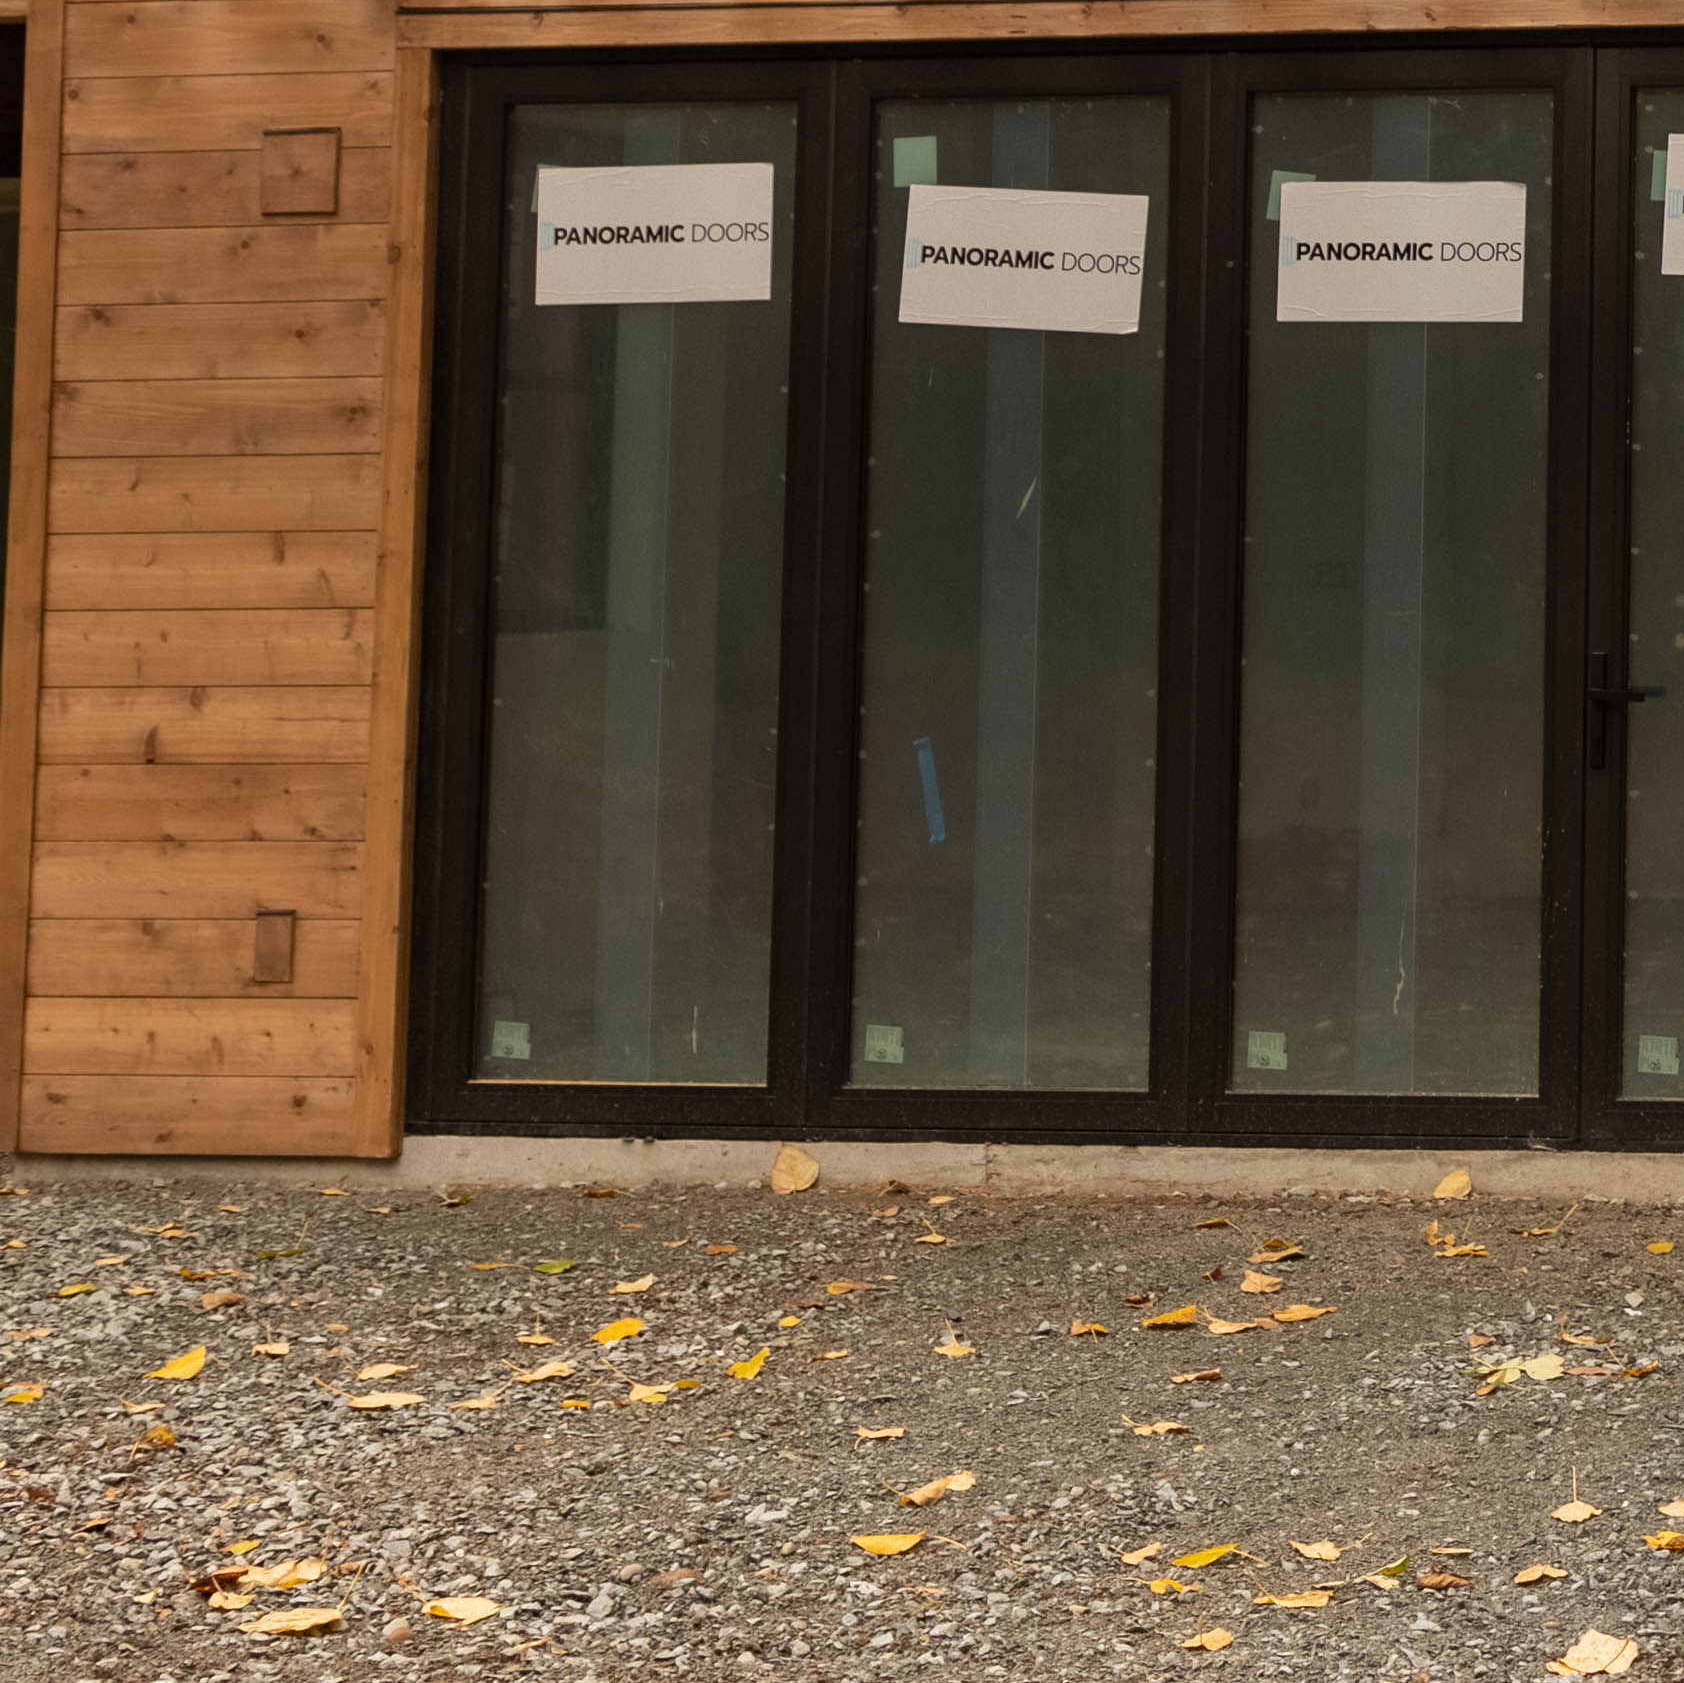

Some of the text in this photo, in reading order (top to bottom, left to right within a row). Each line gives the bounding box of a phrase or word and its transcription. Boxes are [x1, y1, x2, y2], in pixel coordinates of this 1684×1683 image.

[554, 222, 770, 246] PANORAMIC DOORS
[921, 245, 1141, 276] PANORAMIC DOORS
[1296, 242, 1522, 262] PANORAMIC DOORS
